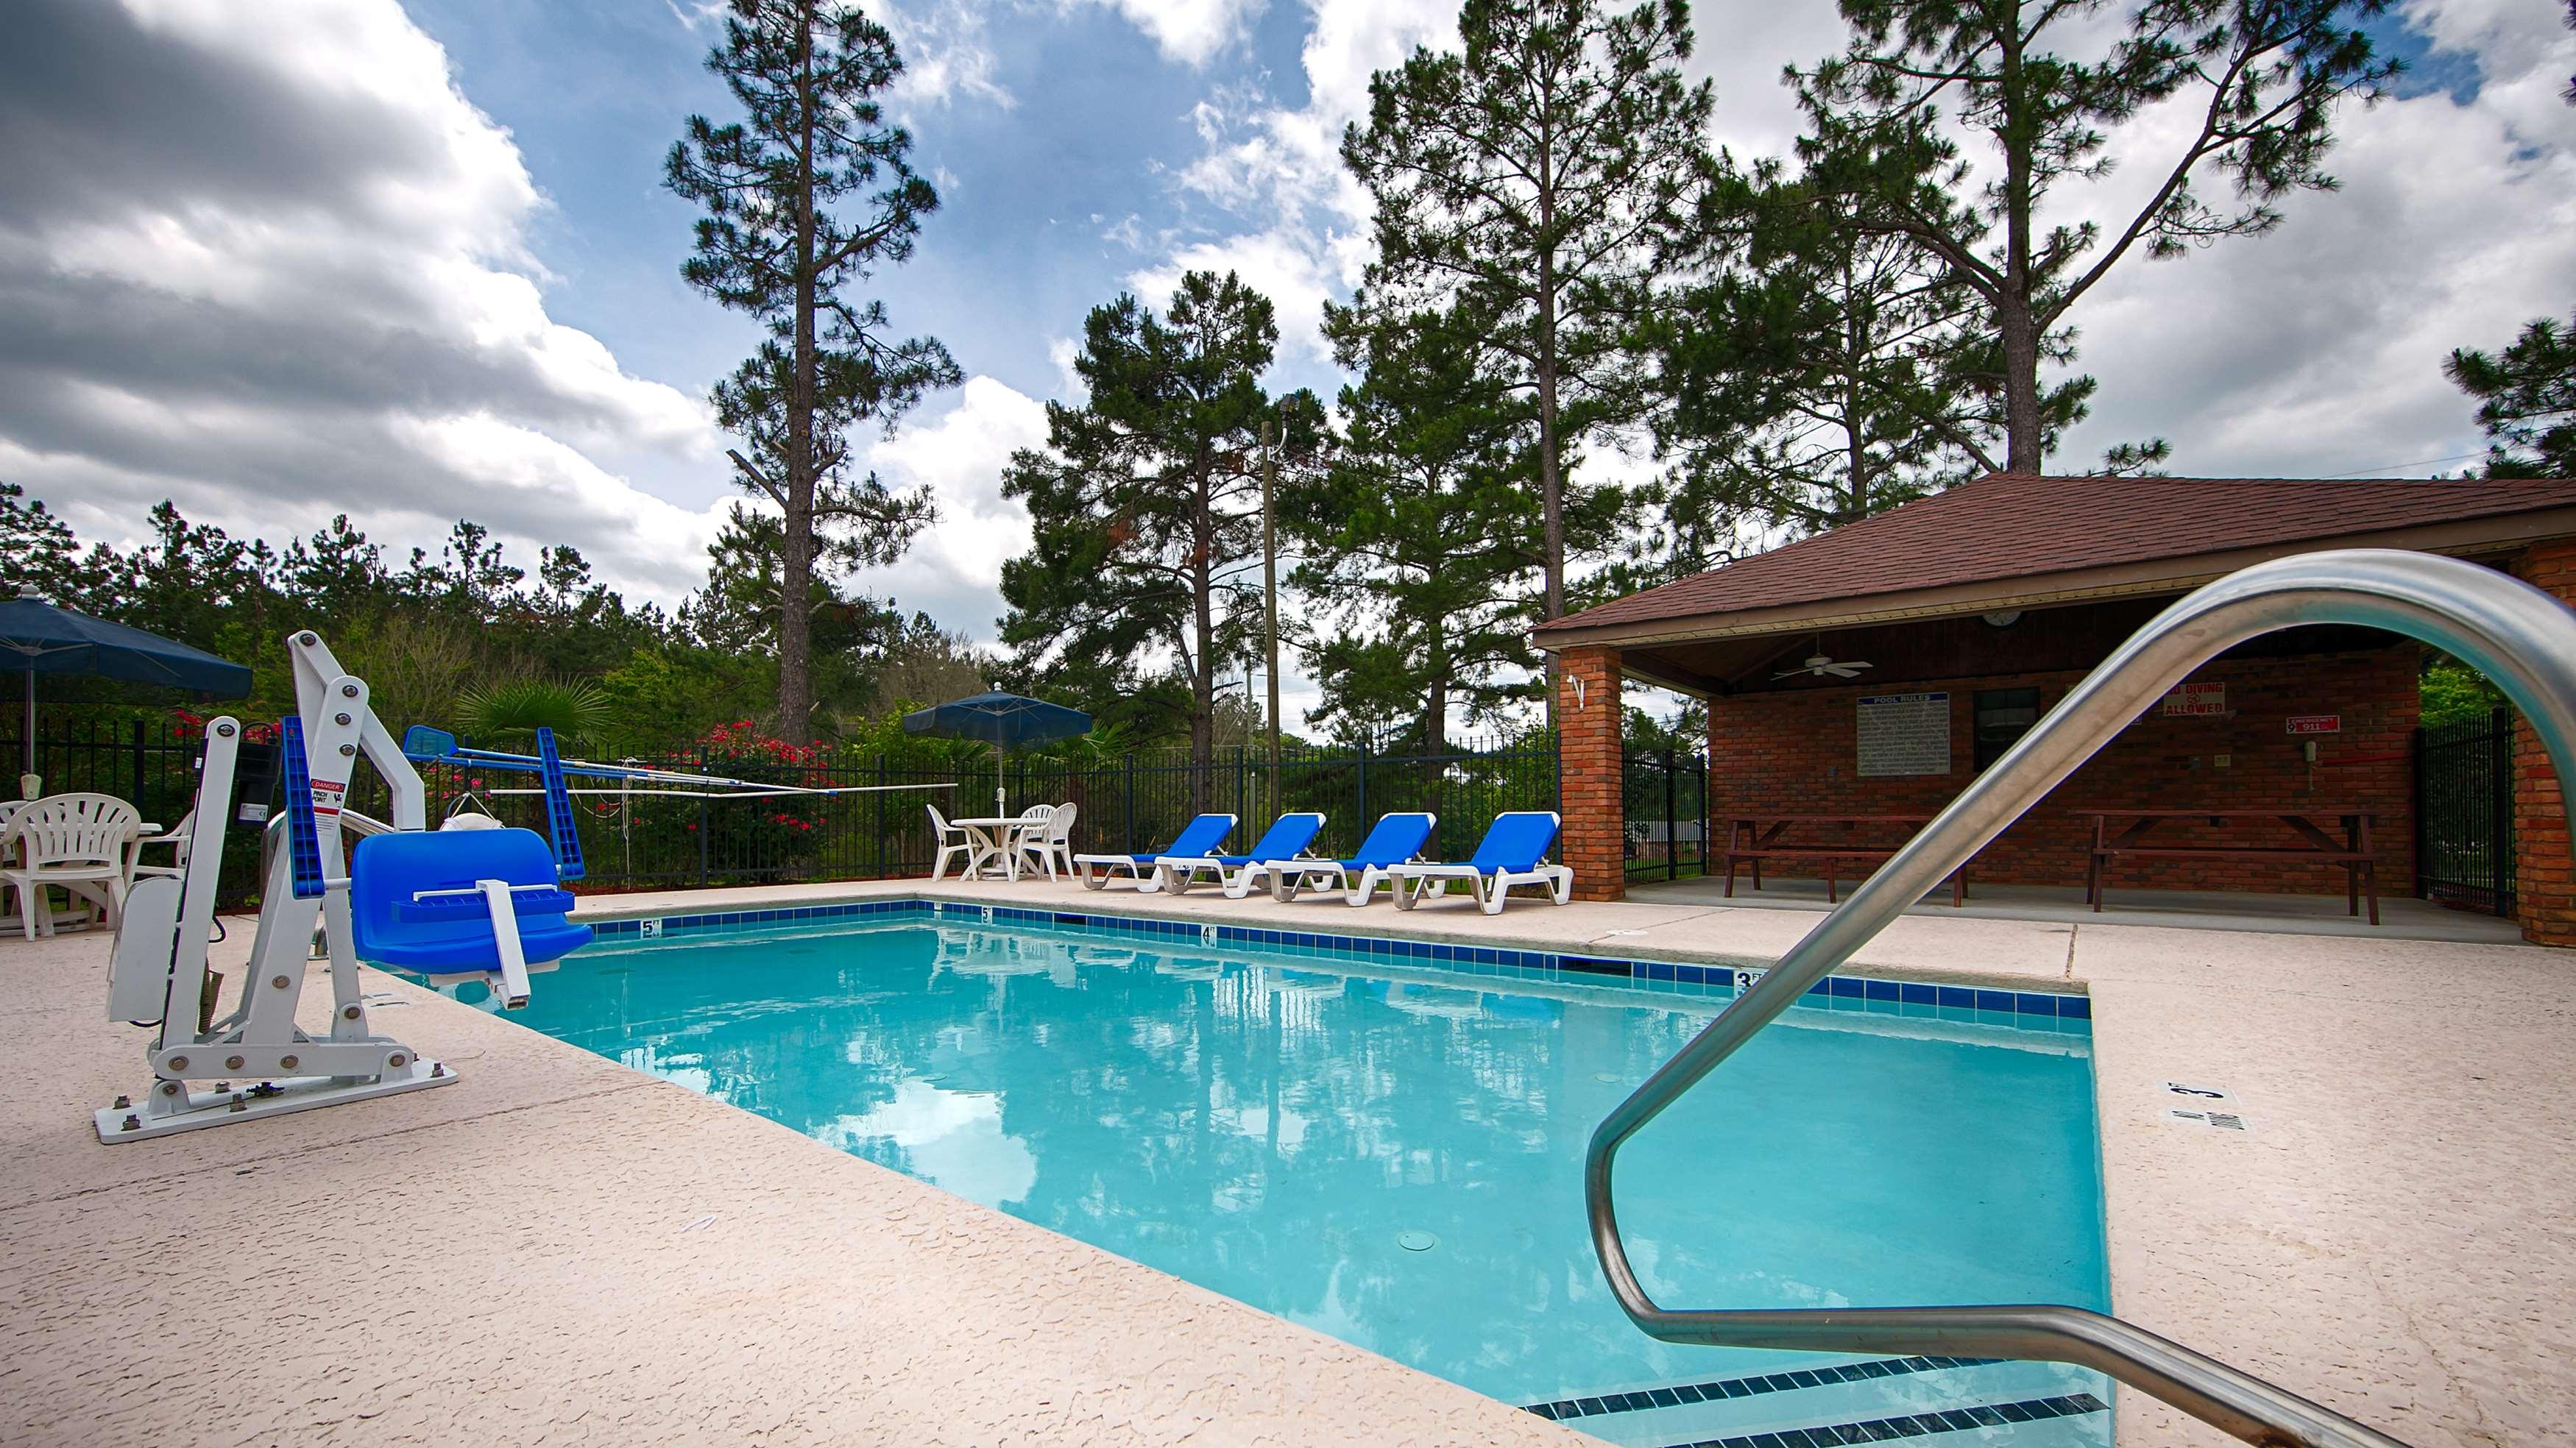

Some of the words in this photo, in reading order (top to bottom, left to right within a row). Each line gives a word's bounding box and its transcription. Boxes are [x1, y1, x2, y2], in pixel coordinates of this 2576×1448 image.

[2186, 683, 2223, 694] DIVING
[2166, 703, 2222, 714] ALLOWED
[315, 781, 340, 790] DANGER
[1203, 926, 1210, 937] 4
[1738, 972, 1751, 987] 3
[2170, 1087, 2223, 1099] 3
